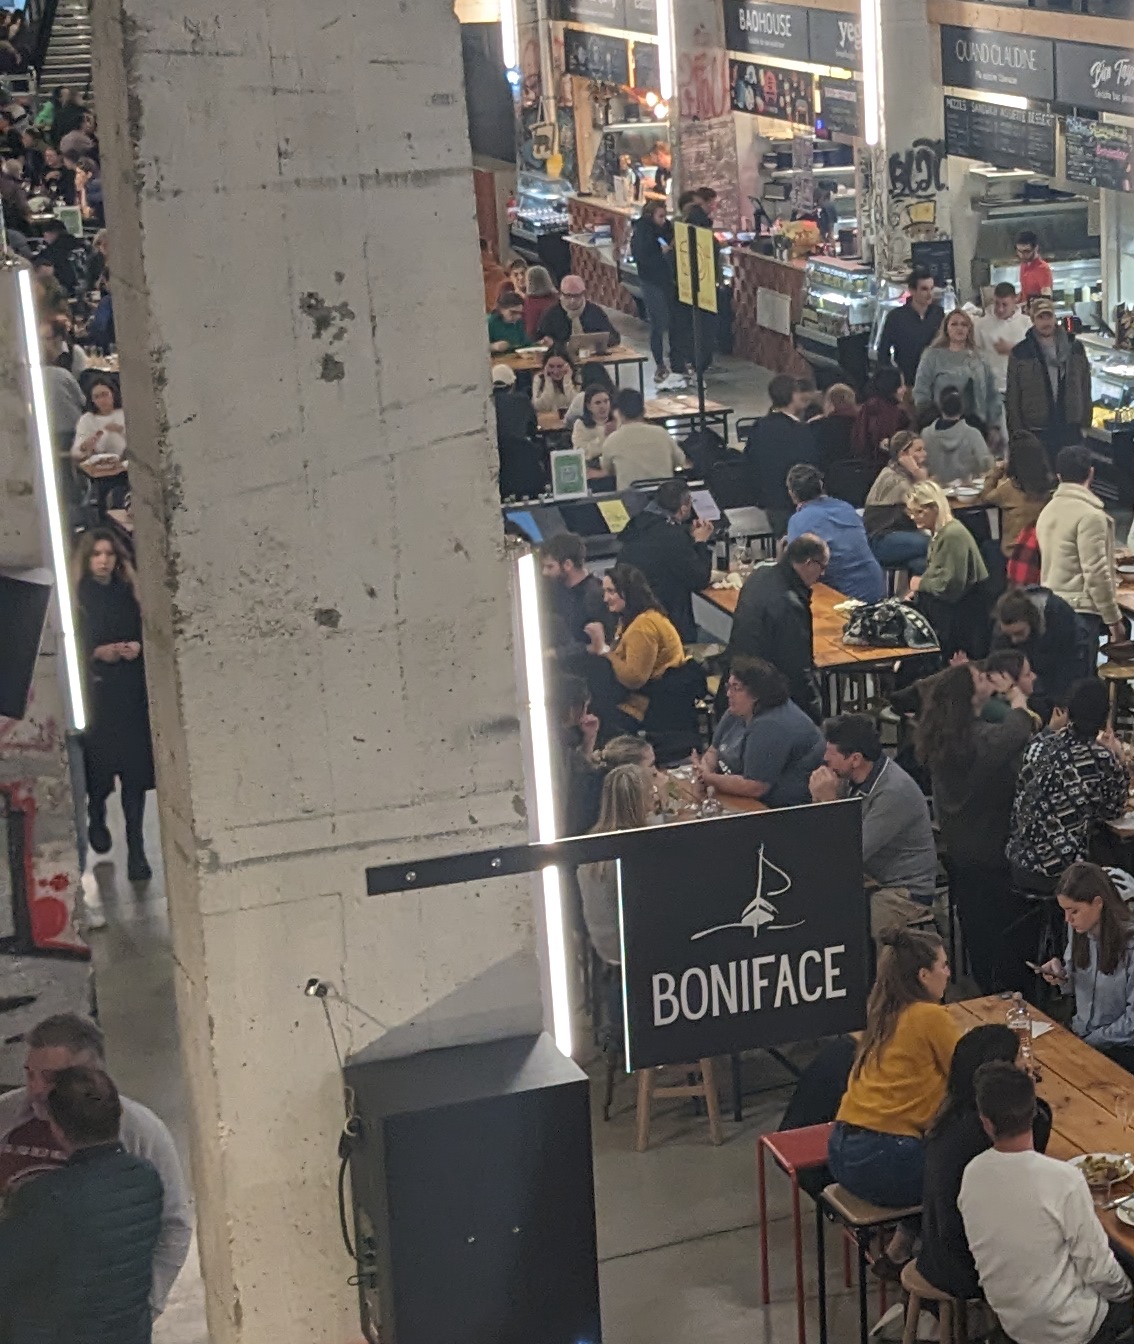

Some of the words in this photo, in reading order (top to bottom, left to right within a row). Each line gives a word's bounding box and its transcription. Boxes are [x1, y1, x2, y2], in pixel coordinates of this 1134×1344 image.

[956, 39, 989, 64] QUAND
[991, 44, 1037, 70] CLAUDINE
[651, 944, 847, 1027] BONIFACE
